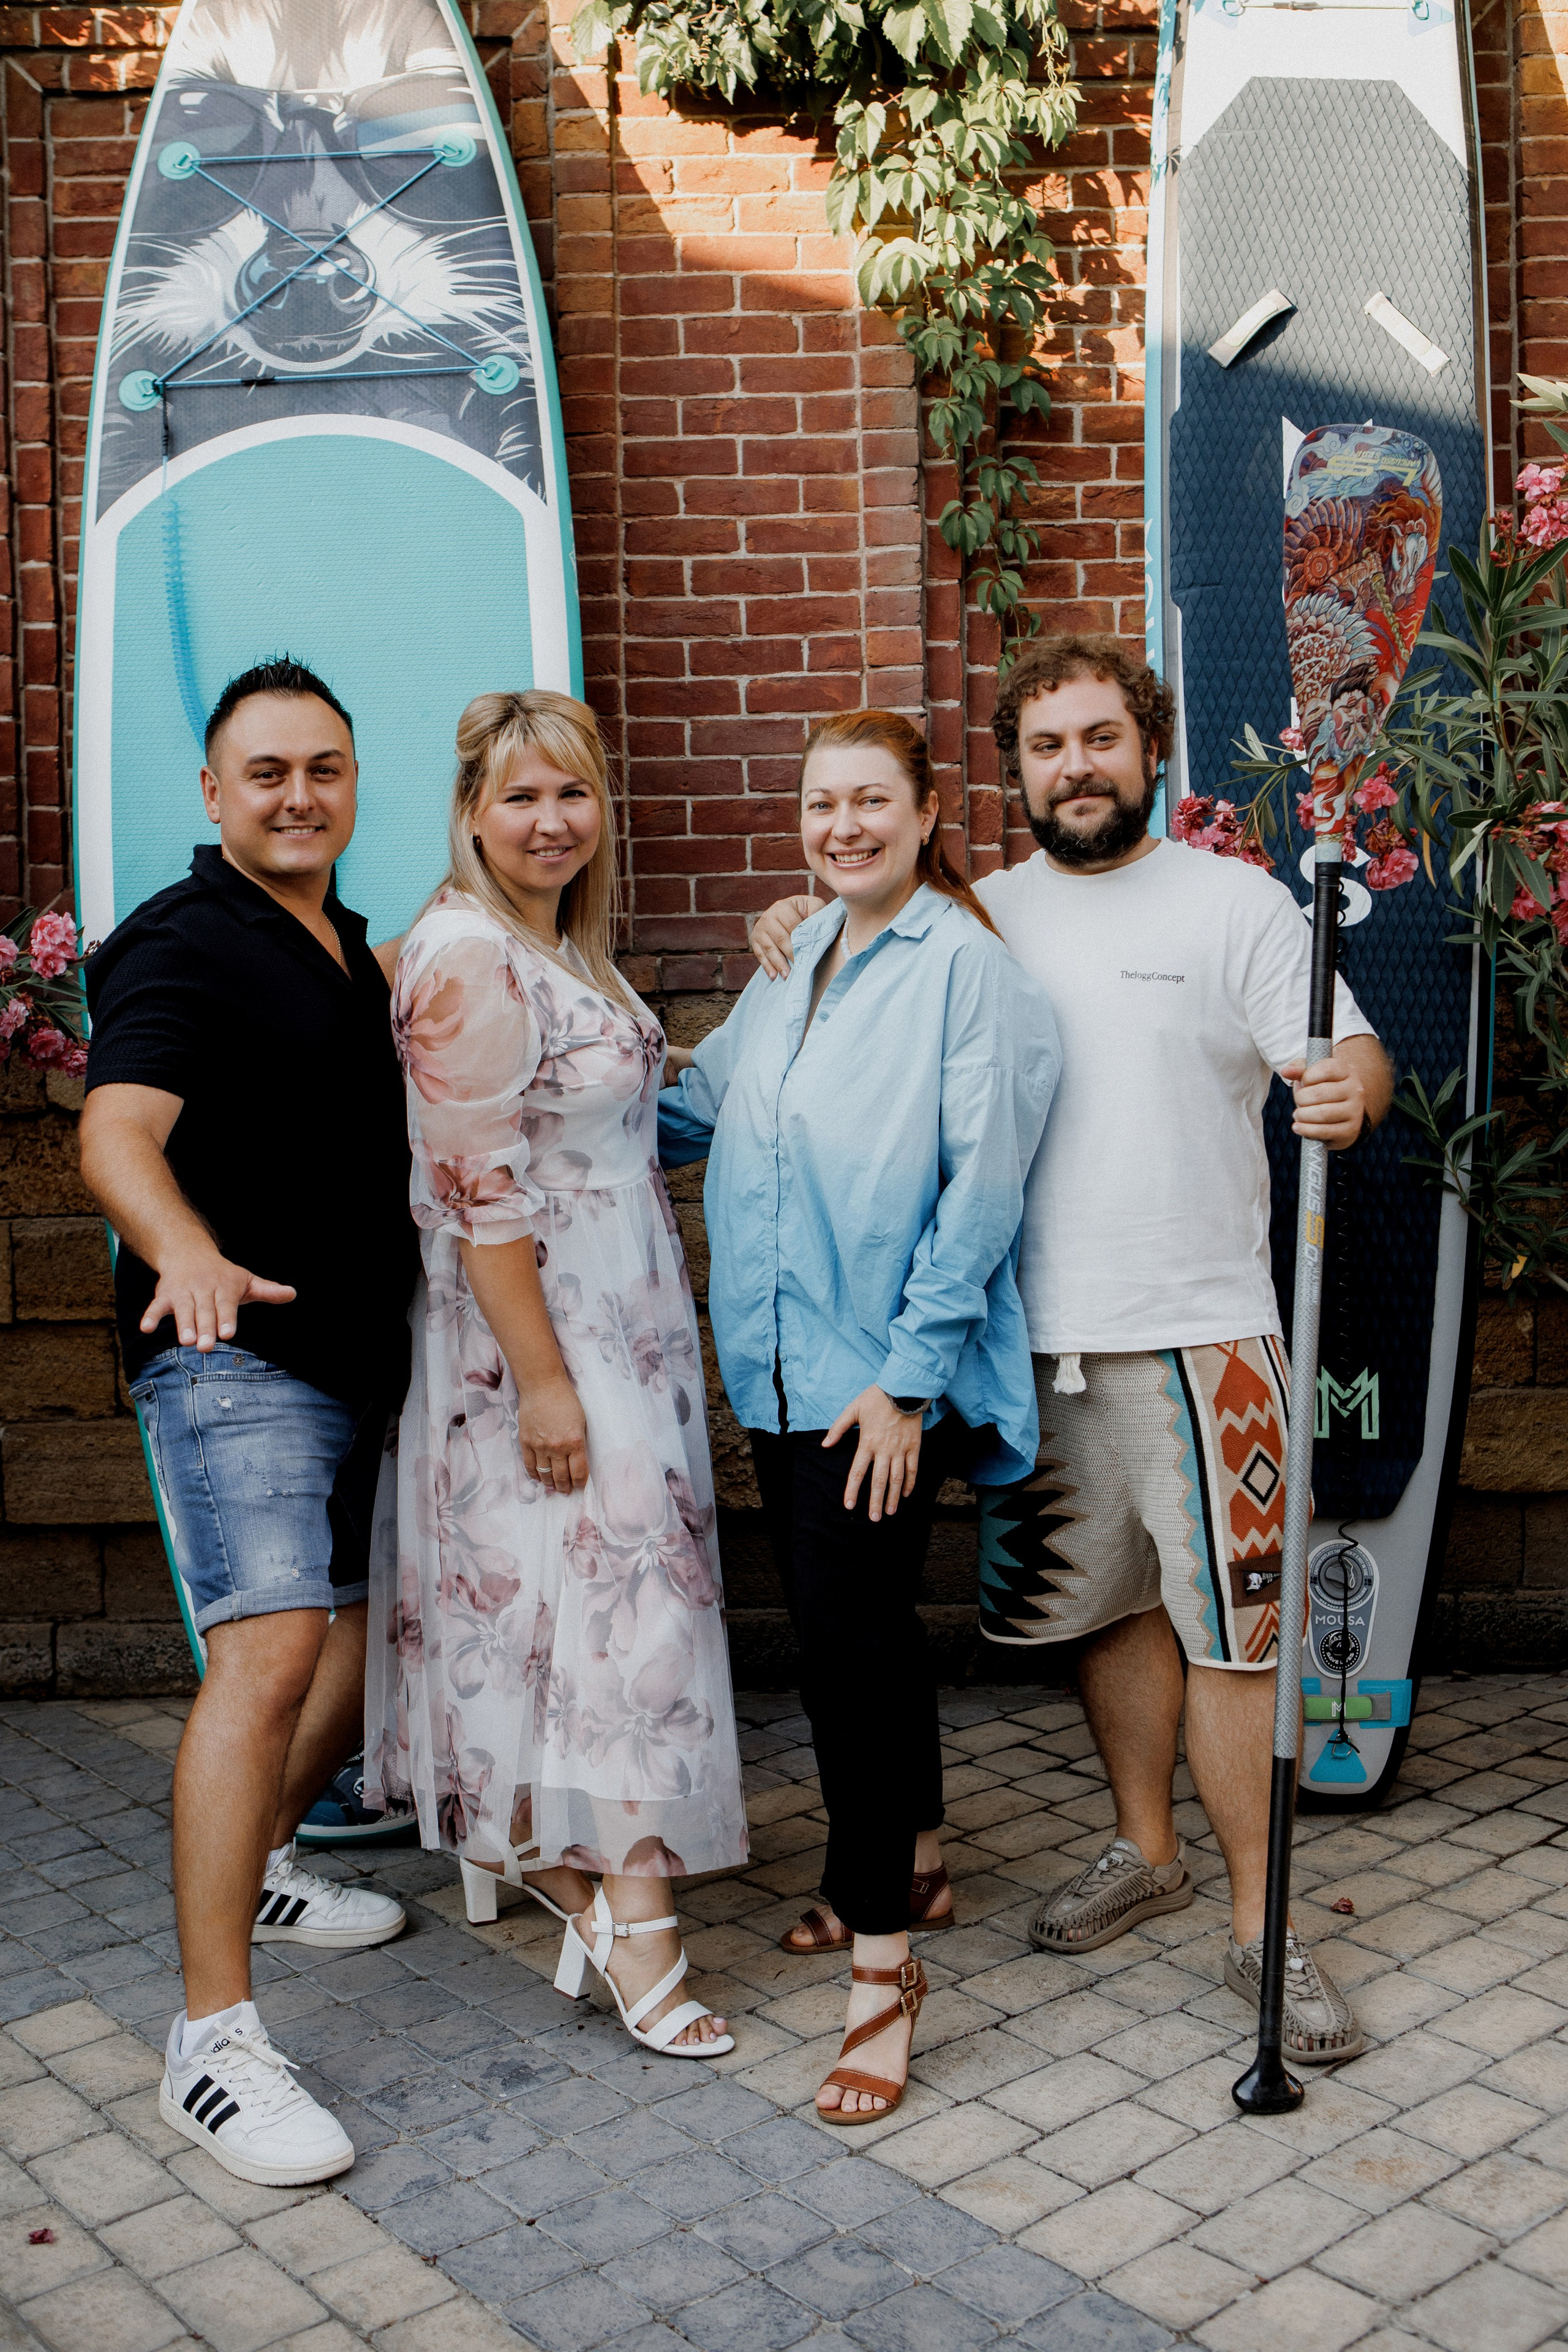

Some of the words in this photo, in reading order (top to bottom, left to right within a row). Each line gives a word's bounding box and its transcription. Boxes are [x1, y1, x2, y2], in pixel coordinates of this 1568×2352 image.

[1120, 970, 1185, 984] TheJoggConcept
[1314, 1585, 1344, 1605] RECOMMENDE
[1315, 1615, 1365, 1626] MOUSA
